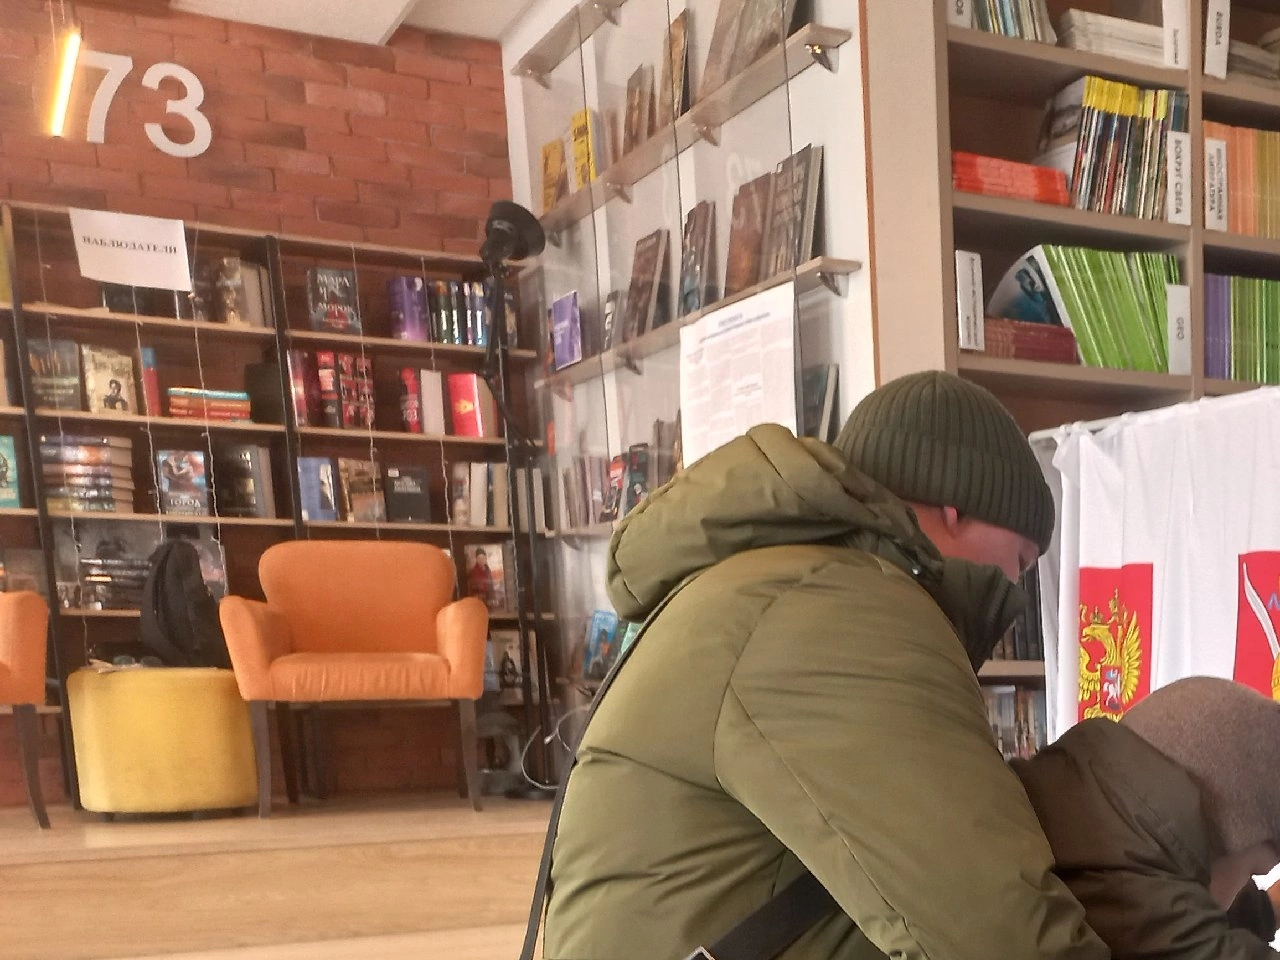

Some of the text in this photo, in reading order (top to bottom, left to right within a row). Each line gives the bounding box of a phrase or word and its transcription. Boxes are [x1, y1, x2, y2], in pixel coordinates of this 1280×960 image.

[1215, 11, 1224, 46] BURDA
[79, 49, 213, 159] 73
[1174, 139, 1183, 215] ВОКРУГ СВЕТА
[82, 235, 177, 255] НАБЛЮДАТЕЛИ
